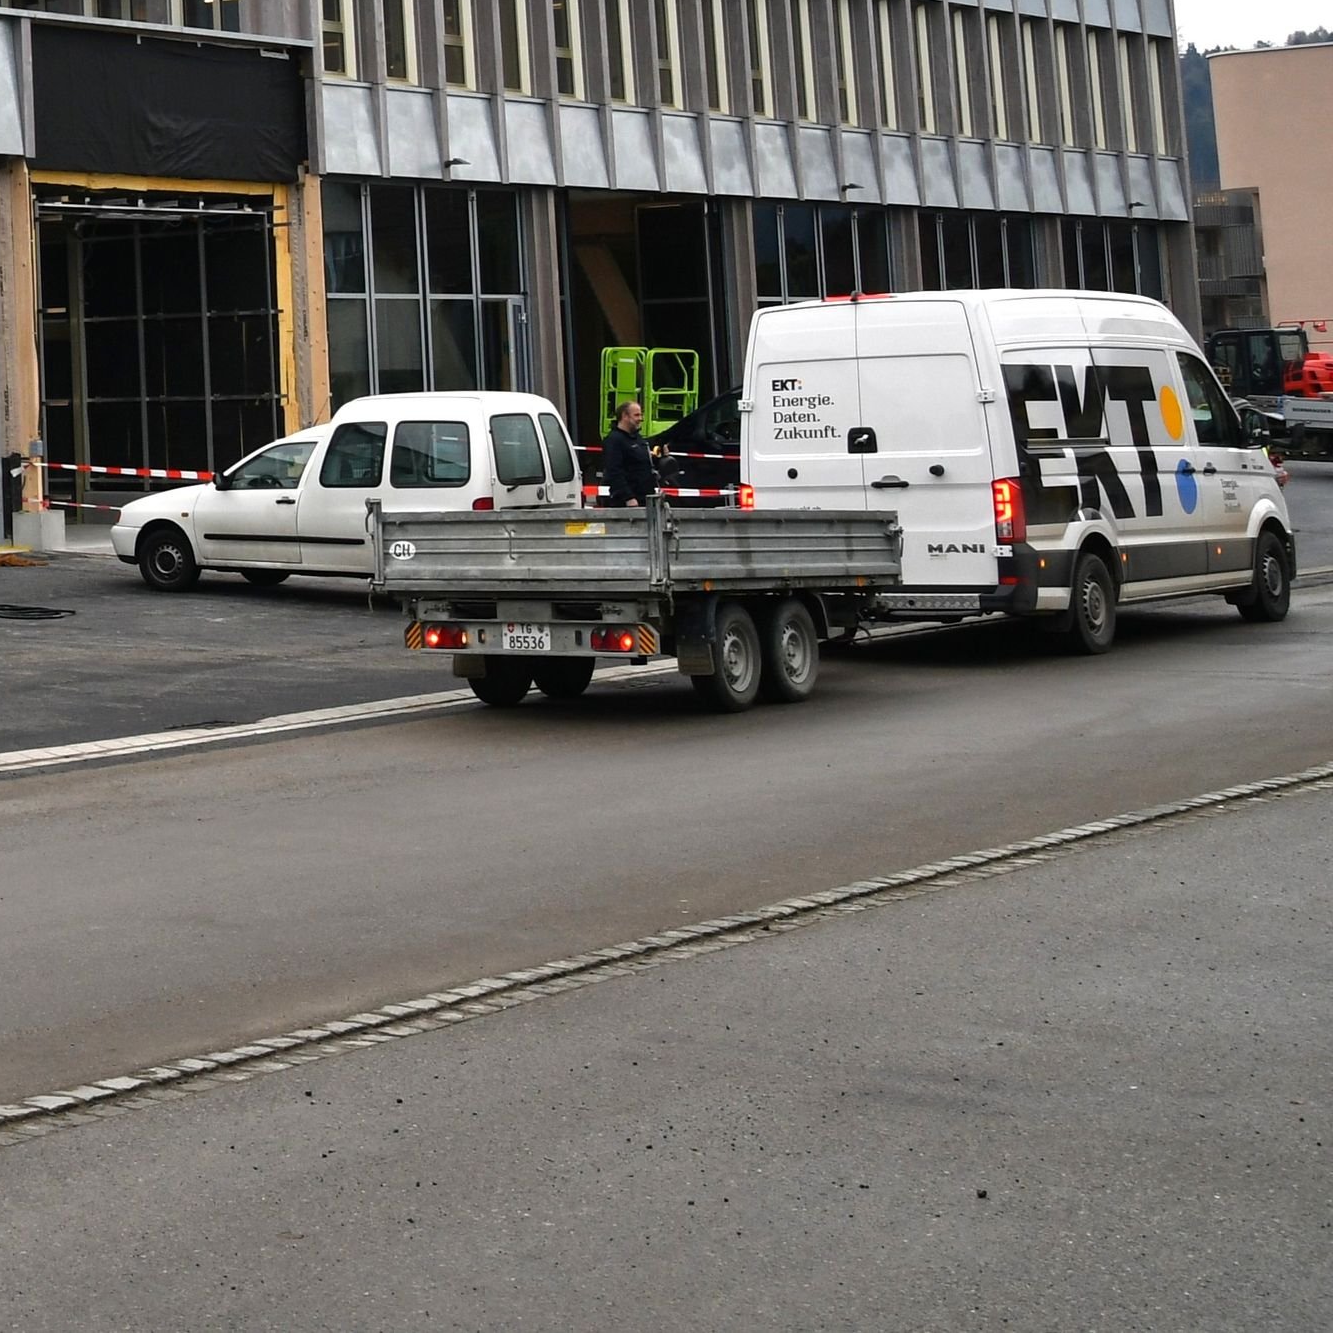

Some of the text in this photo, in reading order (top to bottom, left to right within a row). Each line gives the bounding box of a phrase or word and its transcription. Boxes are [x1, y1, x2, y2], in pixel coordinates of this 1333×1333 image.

[773, 394, 835, 409] Energie.
[773, 411, 820, 424] Daten.
[774, 425, 842, 440] Zukunft.
[393, 543, 411, 557] CH
[509, 635, 545, 650] 85536
